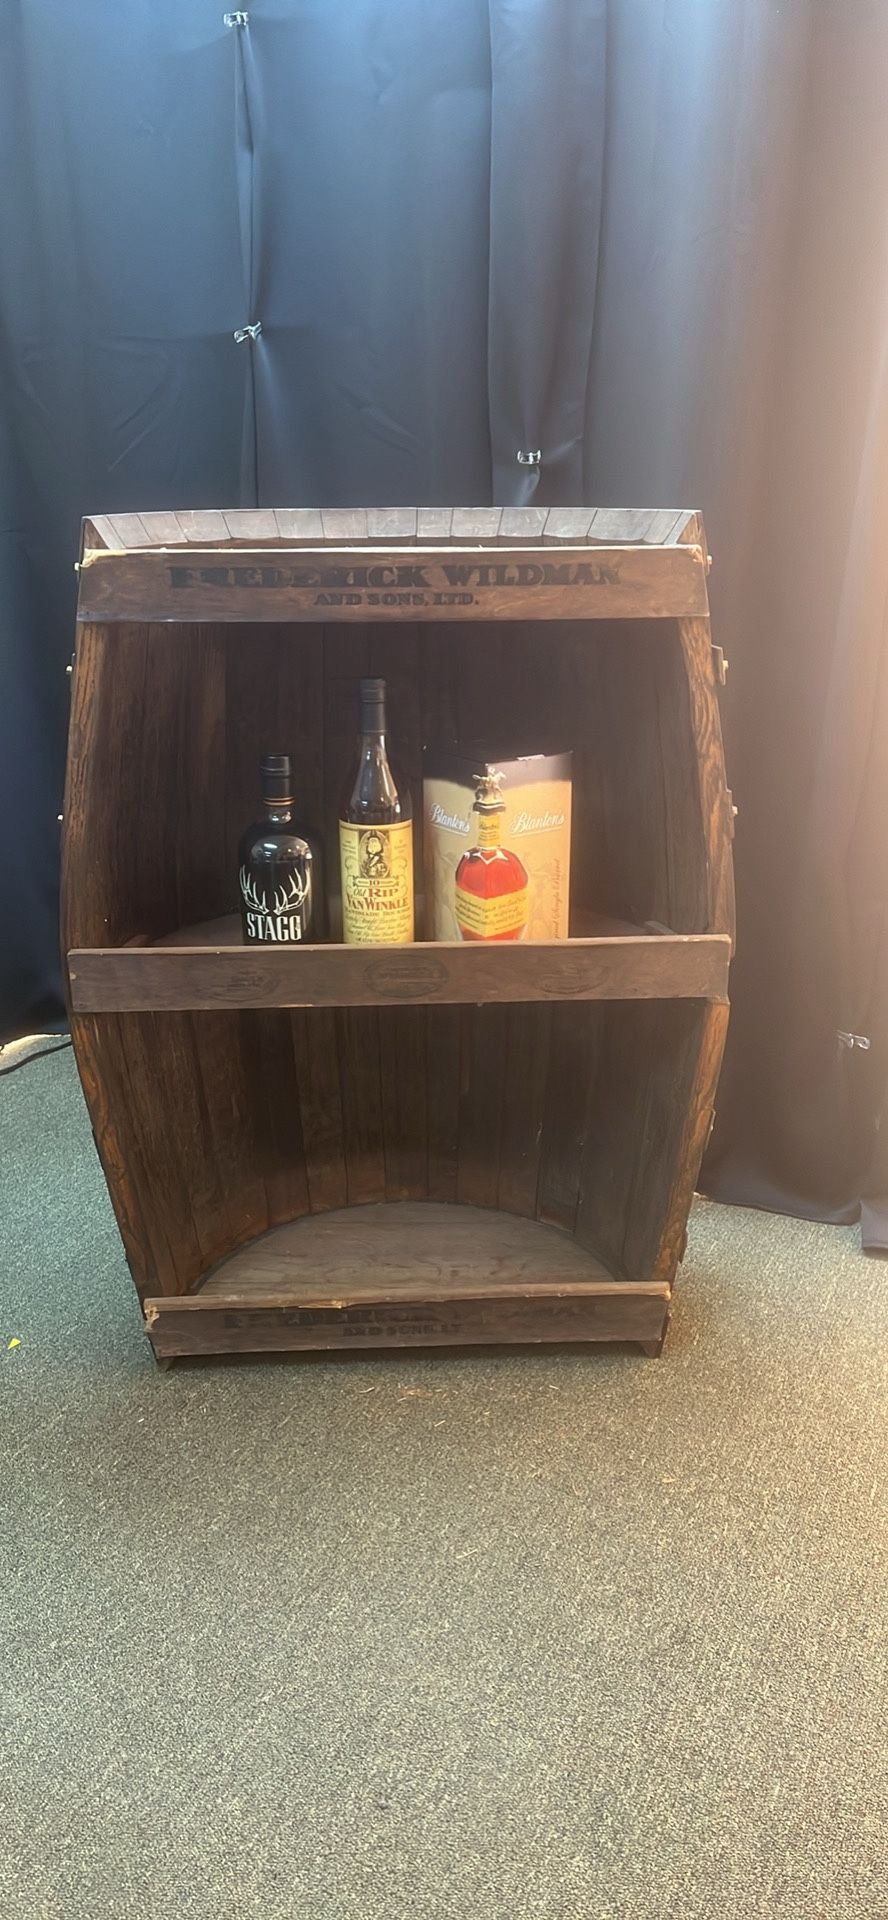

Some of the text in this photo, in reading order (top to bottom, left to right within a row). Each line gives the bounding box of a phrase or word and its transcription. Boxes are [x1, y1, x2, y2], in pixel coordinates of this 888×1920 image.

[168, 563, 622, 588] FREDERICK WILDMAN
[313, 591, 480, 606] AND SONS, LTD.
[246, 912, 302, 942] STAGG
